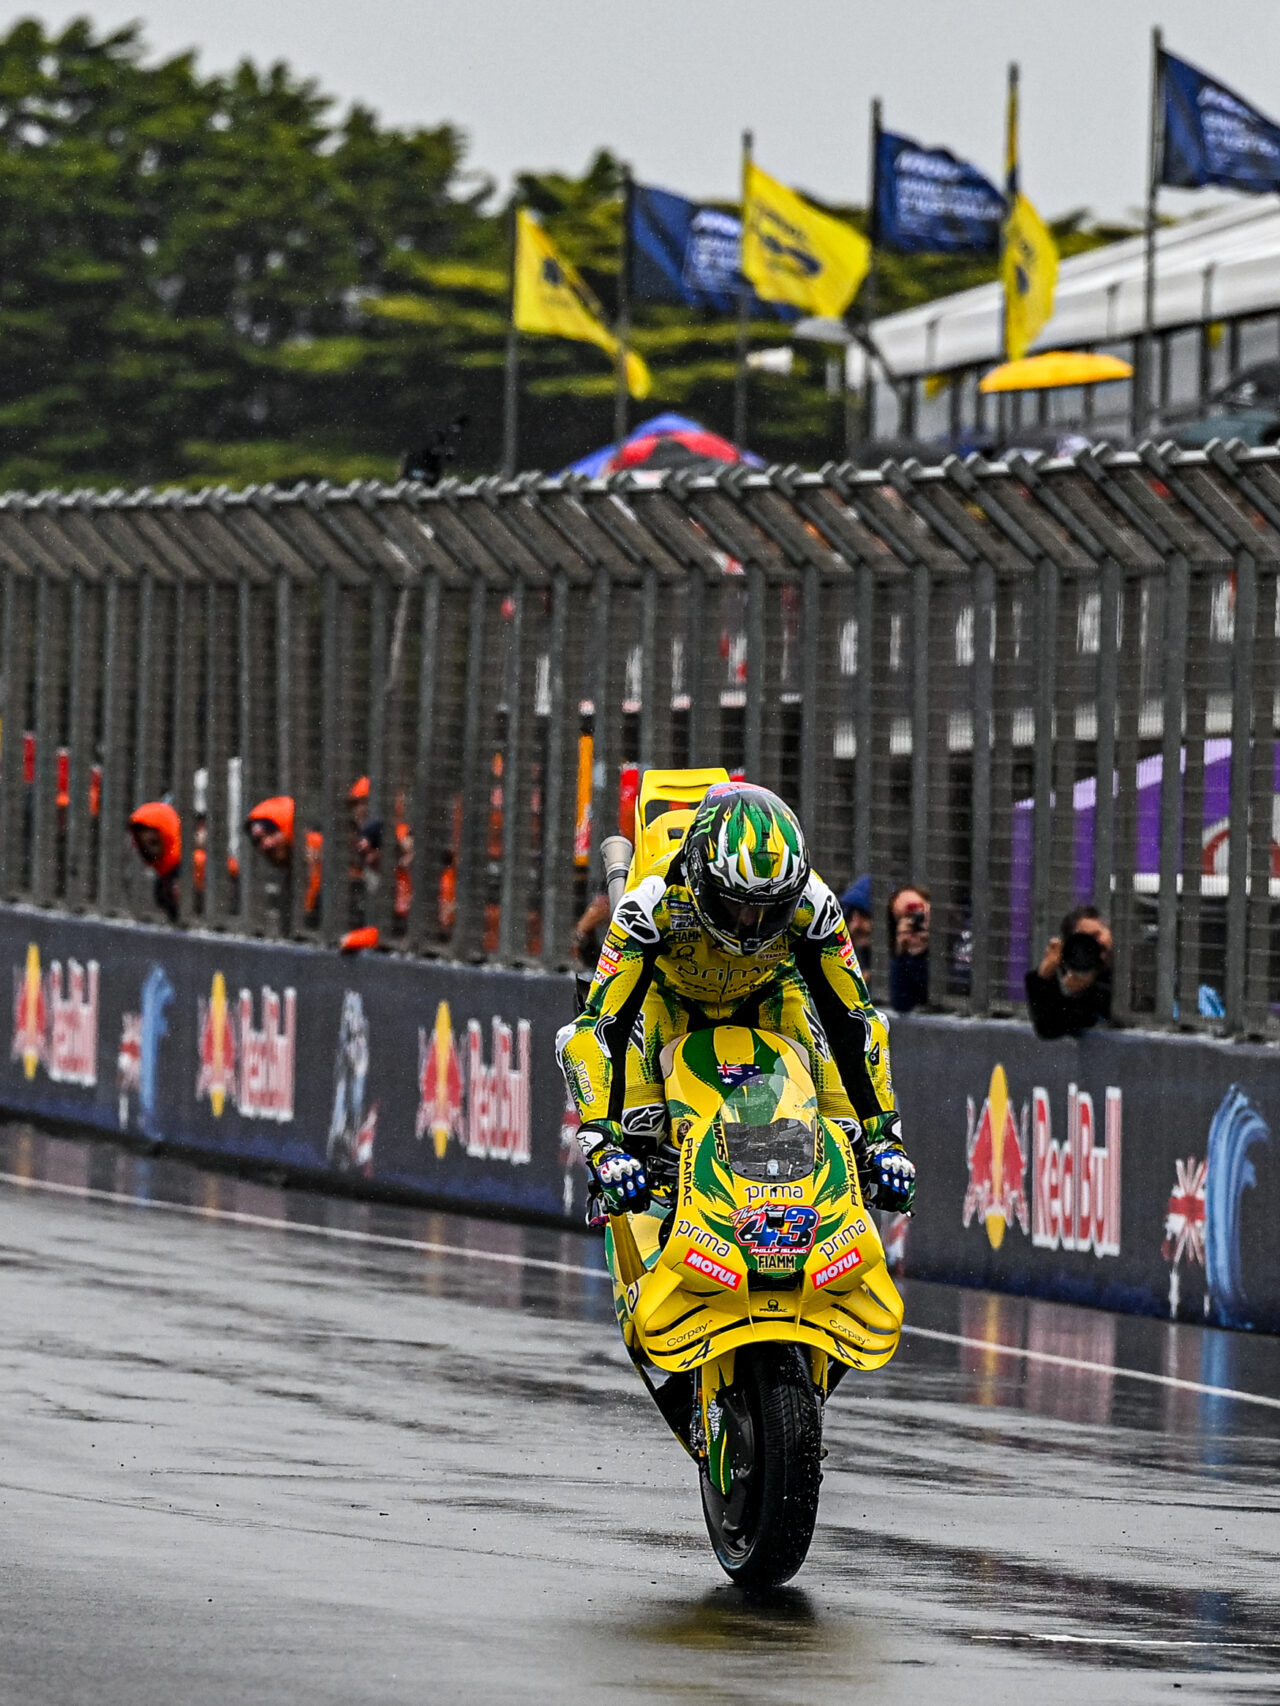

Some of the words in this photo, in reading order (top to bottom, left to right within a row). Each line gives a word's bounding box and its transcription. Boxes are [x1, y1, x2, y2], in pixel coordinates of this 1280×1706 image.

[575, 1060, 595, 1103] prima
[683, 1138, 693, 1207] PRAMAC
[846, 1138, 858, 1207] PRAMAC
[1033, 1082, 1078, 1250] Red
[1076, 1085, 1121, 1257] Bull
[744, 1184, 803, 1204] prima
[675, 1219, 731, 1257] prima
[736, 1206, 820, 1248] 43
[818, 1218, 867, 1262] prima
[686, 1252, 737, 1287] MOTUL
[758, 1255, 795, 1269] FIAMM
[815, 1251, 860, 1286] MOTUL
[666, 1322, 709, 1347] Corpay
[829, 1319, 866, 1345] Corpay
